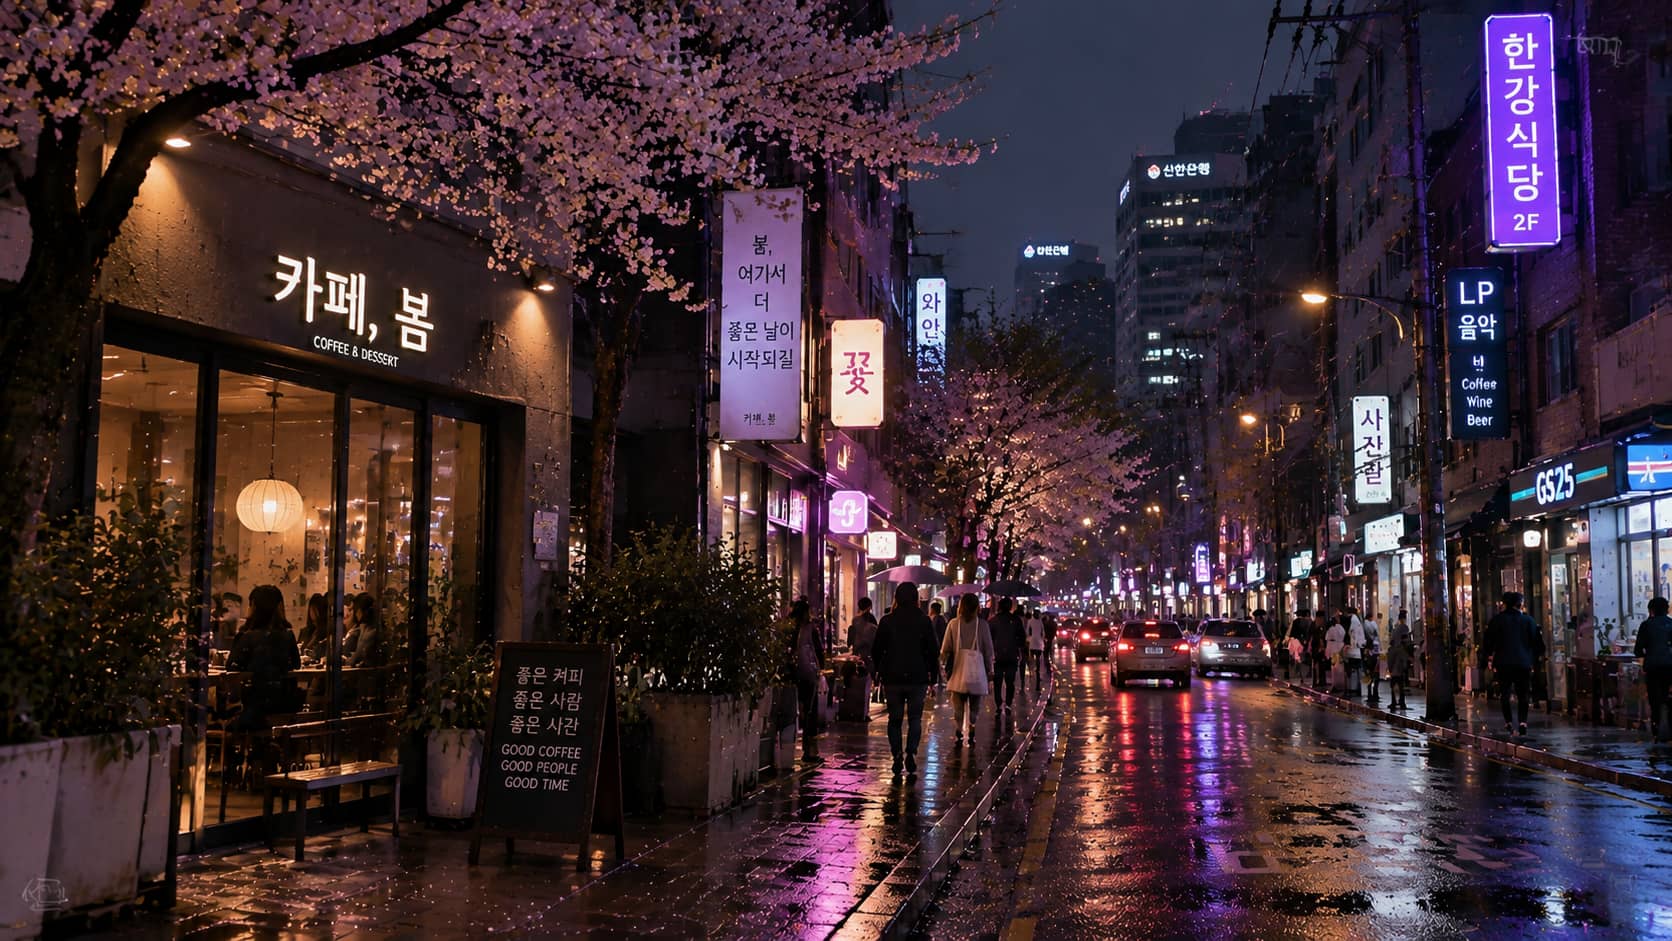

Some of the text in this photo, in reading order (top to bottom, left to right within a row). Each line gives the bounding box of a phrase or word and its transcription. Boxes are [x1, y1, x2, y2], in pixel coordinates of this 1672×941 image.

[1502, 32, 1544, 202] 한강식당
[1513, 213, 1540, 231] 2F
[738, 263, 786, 285] 여기서
[274, 254, 434, 352] 카페, 봄
[754, 291, 768, 312] 더
[1459, 281, 1494, 305] LP
[1458, 313, 1497, 341] 음악
[313, 335, 400, 368] COFFEE & DESSERT
[1461, 378, 1498, 390] Coffee
[1466, 395, 1493, 409] Wine
[1536, 462, 1575, 505] GS25
[550, 691, 583, 711] 사람
[501, 744, 582, 760] GOOD COFFEE
[501, 760, 578, 775] GOOD PEOPLE
[504, 776, 570, 791] GOOD TIME
